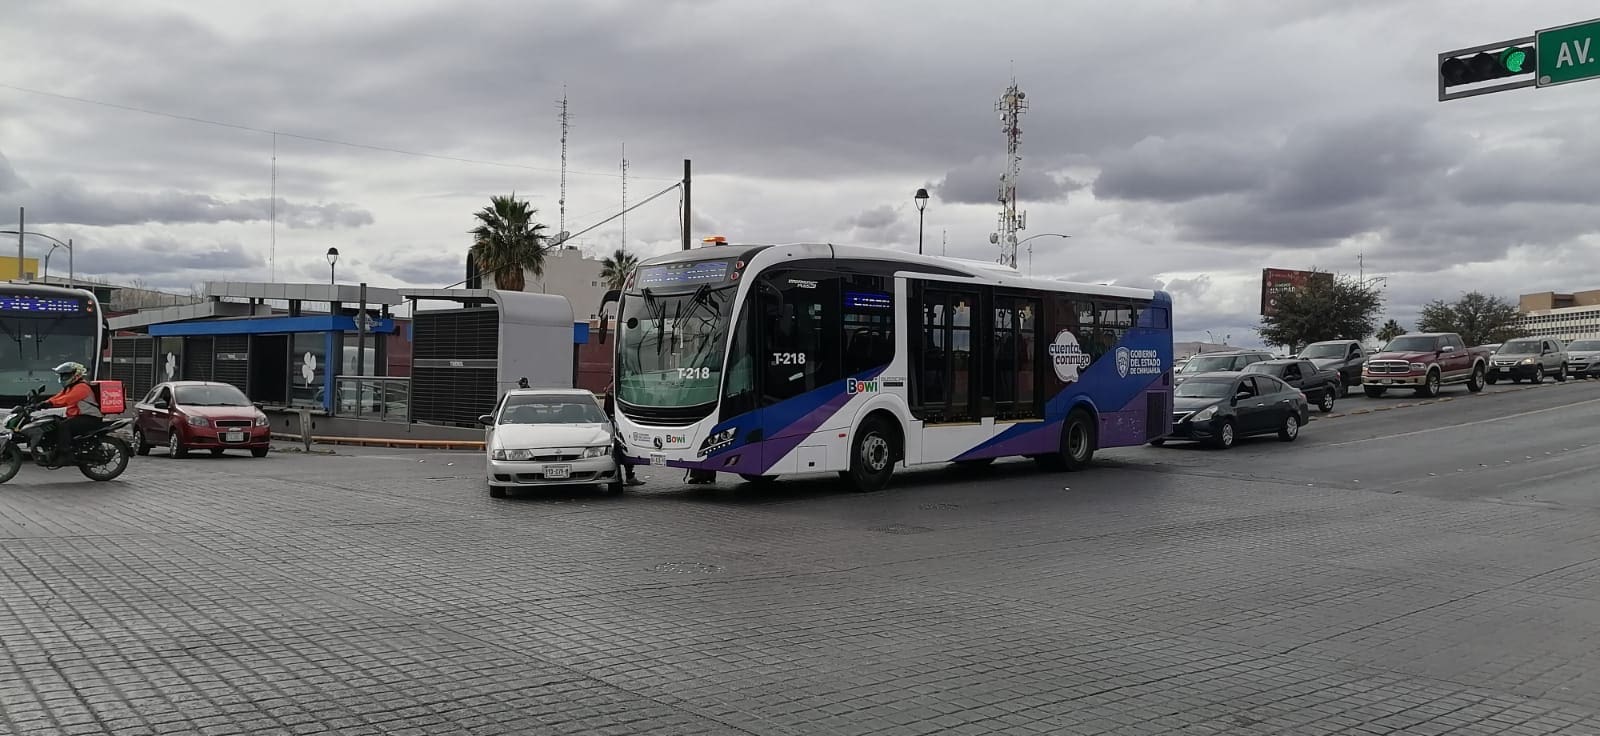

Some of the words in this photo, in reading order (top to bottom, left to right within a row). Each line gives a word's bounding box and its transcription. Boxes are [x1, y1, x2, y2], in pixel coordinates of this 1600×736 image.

[1556, 38, 1595, 68] AV.
[1049, 342, 1080, 354] cuenta
[1130, 350, 1157, 358] GOBIERNO
[772, 352, 806, 365] T-218
[1055, 351, 1090, 368] conmigo
[1130, 359, 1141, 367] DEL
[1141, 359, 1161, 367] ESTADO
[677, 367, 710, 379] T-218
[1130, 367, 1136, 375] DE
[847, 377, 879, 394] Bowi
[666, 434, 686, 443] Bowi
